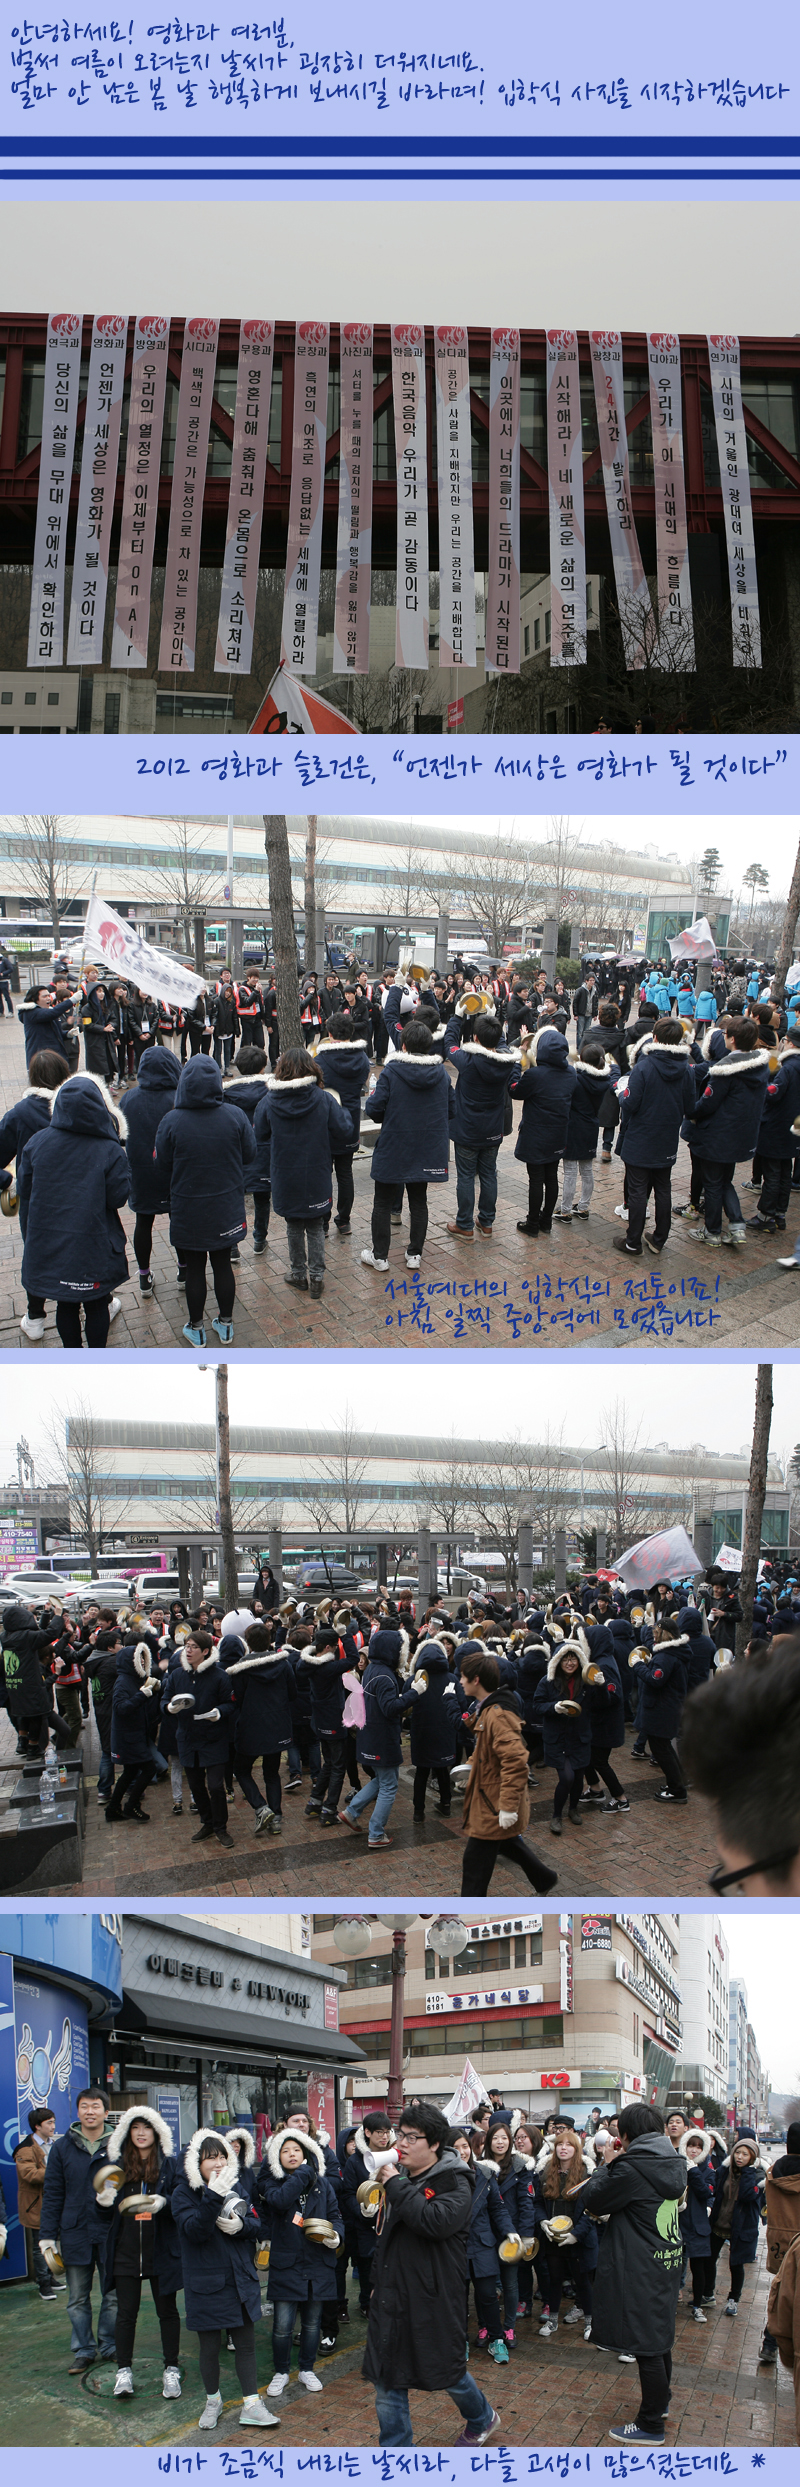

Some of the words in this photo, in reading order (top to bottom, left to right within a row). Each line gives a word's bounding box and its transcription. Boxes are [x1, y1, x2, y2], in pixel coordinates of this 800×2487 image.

[48, 337, 80, 349] 연극과
[93, 336, 125, 349] 영화과
[135, 339, 166, 352] 방영과
[184, 340, 217, 353] 시디과
[241, 344, 272, 356] 무용과
[297, 345, 327, 357] 문창과
[342, 346, 373, 357] 사진과
[392, 347, 423, 358] 한음과
[436, 347, 467, 359] 실디과
[491, 351, 519, 363] 극작과
[548, 351, 577, 363] 실음과
[592, 350, 621, 362] 광창과
[650, 354, 679, 365] 디아과
[710, 352, 739, 364] 연기과
[55, 364, 71, 412] 당신의
[98, 364, 113, 412] 언젠가
[141, 365, 156, 413] 우리의
[190, 368, 203, 407] 백색의
[245, 370, 260, 435] 영혼다해
[305, 372, 316, 412] 흑연의
[353, 370, 361, 401] 셔터를
[402, 372, 416, 437] 한국음악
[448, 370, 457, 401] 공간은
[658, 379, 673, 426] 우리가
[721, 378, 734, 421] 시대의
[353, 409, 361, 429] 누를
[449, 409, 458, 441] 사람을
[500, 377, 512, 437] 이곳에서
[556, 376, 571, 456] 시작해라!
[606, 376, 619, 441] 24시간
[53, 425, 68, 457] 삶을
[93, 424, 109, 474] 세상은
[137, 424, 151, 473] 열정은
[187, 417, 199, 457] 공간은
[303, 424, 314, 465] 어조로
[352, 437, 360, 457] 때의
[662, 447, 674, 462] 이
[725, 432, 737, 477] 거울인
[50, 470, 64, 503] 무대
[241, 448, 255, 497] 춤춰라
[352, 465, 360, 498] 검지의
[404, 449, 417, 499] 우리가
[450, 449, 460, 506] 지배하지만
[500, 449, 512, 510] 너희들의
[559, 469, 572, 483] 네
[88, 487, 104, 539] 영화가
[132, 485, 147, 554] 이제부터
[181, 467, 196, 536] 가능성으로
[300, 478, 312, 535] 응답없는
[405, 512, 417, 526] 곧
[560, 495, 574, 545] 새로운
[664, 483, 676, 534] 시대의
[729, 489, 741, 535] 광대여
[45, 516, 61, 569] 위에서
[234, 509, 250, 577] 온몸으로
[451, 514, 460, 548] 우리는
[85, 553, 99, 568] 될
[179, 548, 190, 559] 차
[296, 548, 308, 591] 세계에
[499, 523, 511, 588] 드라마가
[734, 547, 746, 594] 세상을
[131, 565, 140, 597] On
[177, 570, 188, 597] 있는
[404, 539, 419, 612] 감동이다
[452, 557, 461, 592] 공간을
[561, 558, 575, 591] 삶의
[666, 555, 684, 627] 흐름이다
[39, 583, 56, 657] 확인하라
[81, 581, 96, 635] 것이다
[227, 592, 244, 662] 소리쳐라
[348, 601, 357, 623] 잃지
[128, 608, 136, 656] Air
[171, 607, 185, 666] 공간이다
[347, 631, 356, 666] 않기를
[453, 602, 462, 663] 지배합니다
[497, 601, 510, 668] 시작된다
[561, 604, 576, 658] 연주를
[582, 1938, 612, 1950] 410-6880
[232, 1978, 242, 1990] &
[326, 1986, 338, 1998] A&F
[541, 2073, 570, 2088] K2
[317, 2082, 326, 2131] SALE
